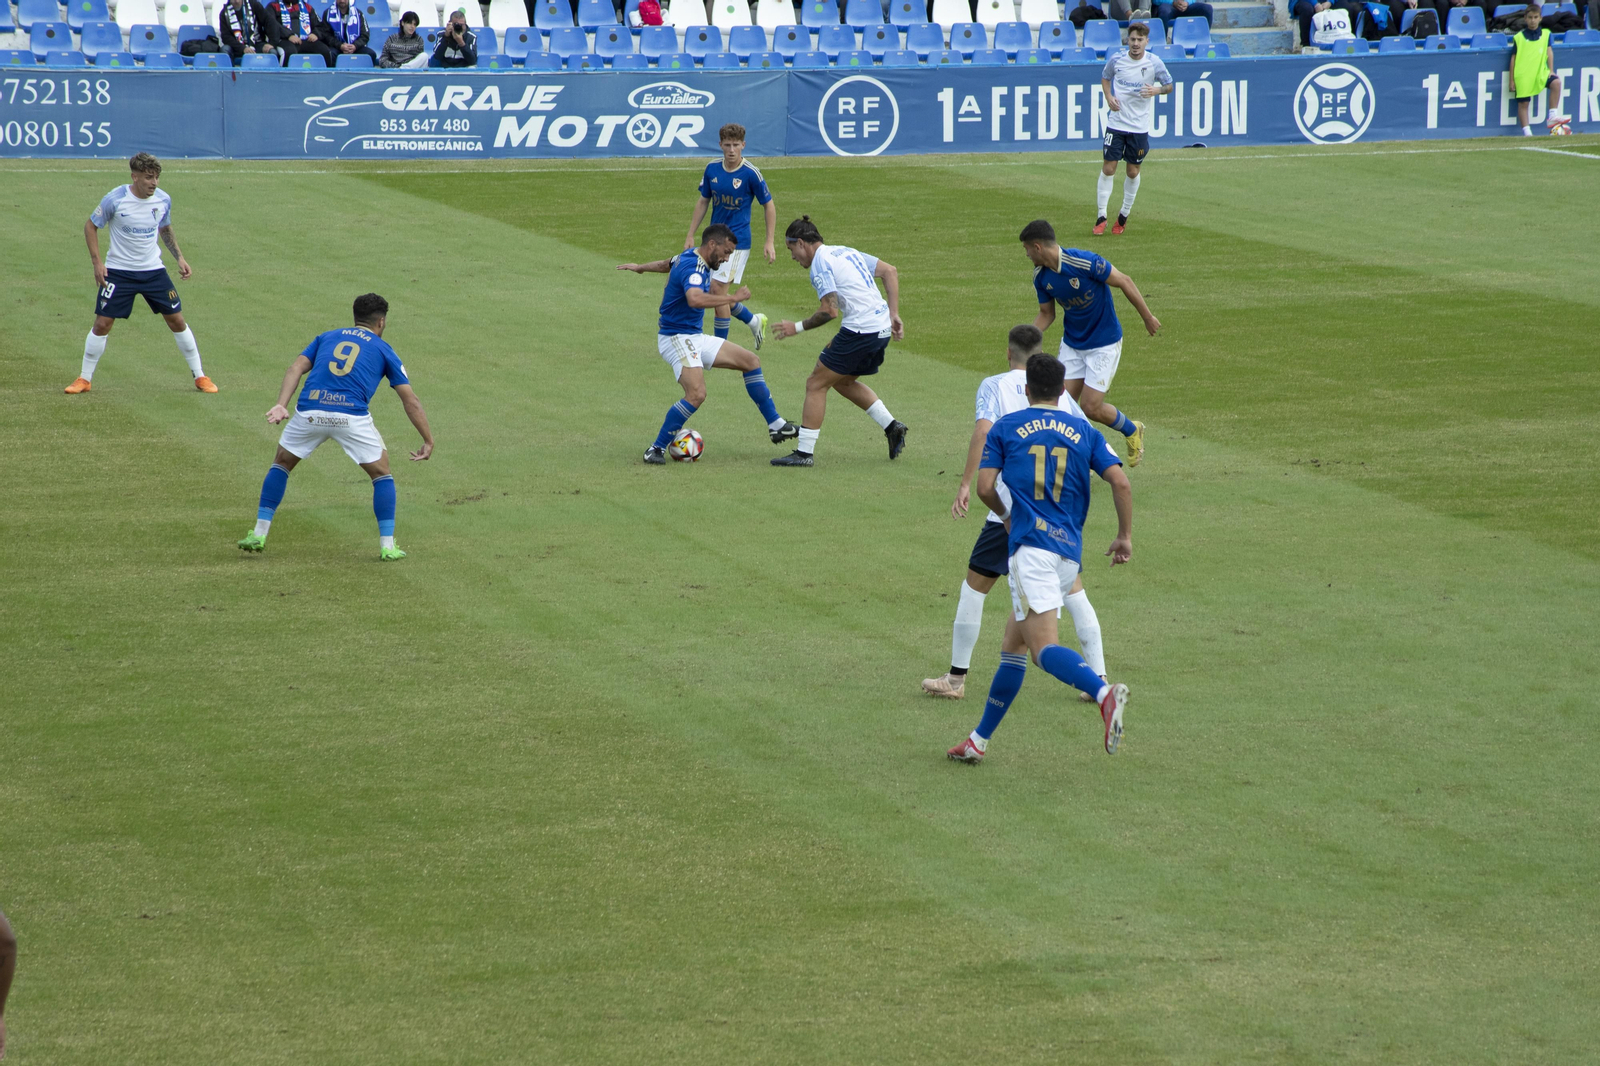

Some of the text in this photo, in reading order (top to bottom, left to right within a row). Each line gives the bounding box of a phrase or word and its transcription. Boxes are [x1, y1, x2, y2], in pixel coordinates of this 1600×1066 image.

[0, 78, 111, 105] 752138
[382, 84, 565, 111] GARAJE
[642, 92, 702, 104] EuroTaller
[991, 71, 1248, 141] FEDERCIÓN
[0, 120, 112, 148] 080155
[379, 118, 470, 132] 953 647 480
[493, 112, 706, 148] MOTOR
[362, 138, 484, 151] ELECTROMECÁNICA
[722, 194, 744, 206] MLC
[101, 280, 116, 299] 19
[1067, 289, 1095, 307] MLC
[341, 329, 373, 342] MENA
[685, 338, 696, 352] 8
[328, 340, 361, 377] 9
[320, 389, 346, 402] Jaén
[1016, 418, 1082, 444] BERLANGA
[1028, 444, 1069, 503] 11
